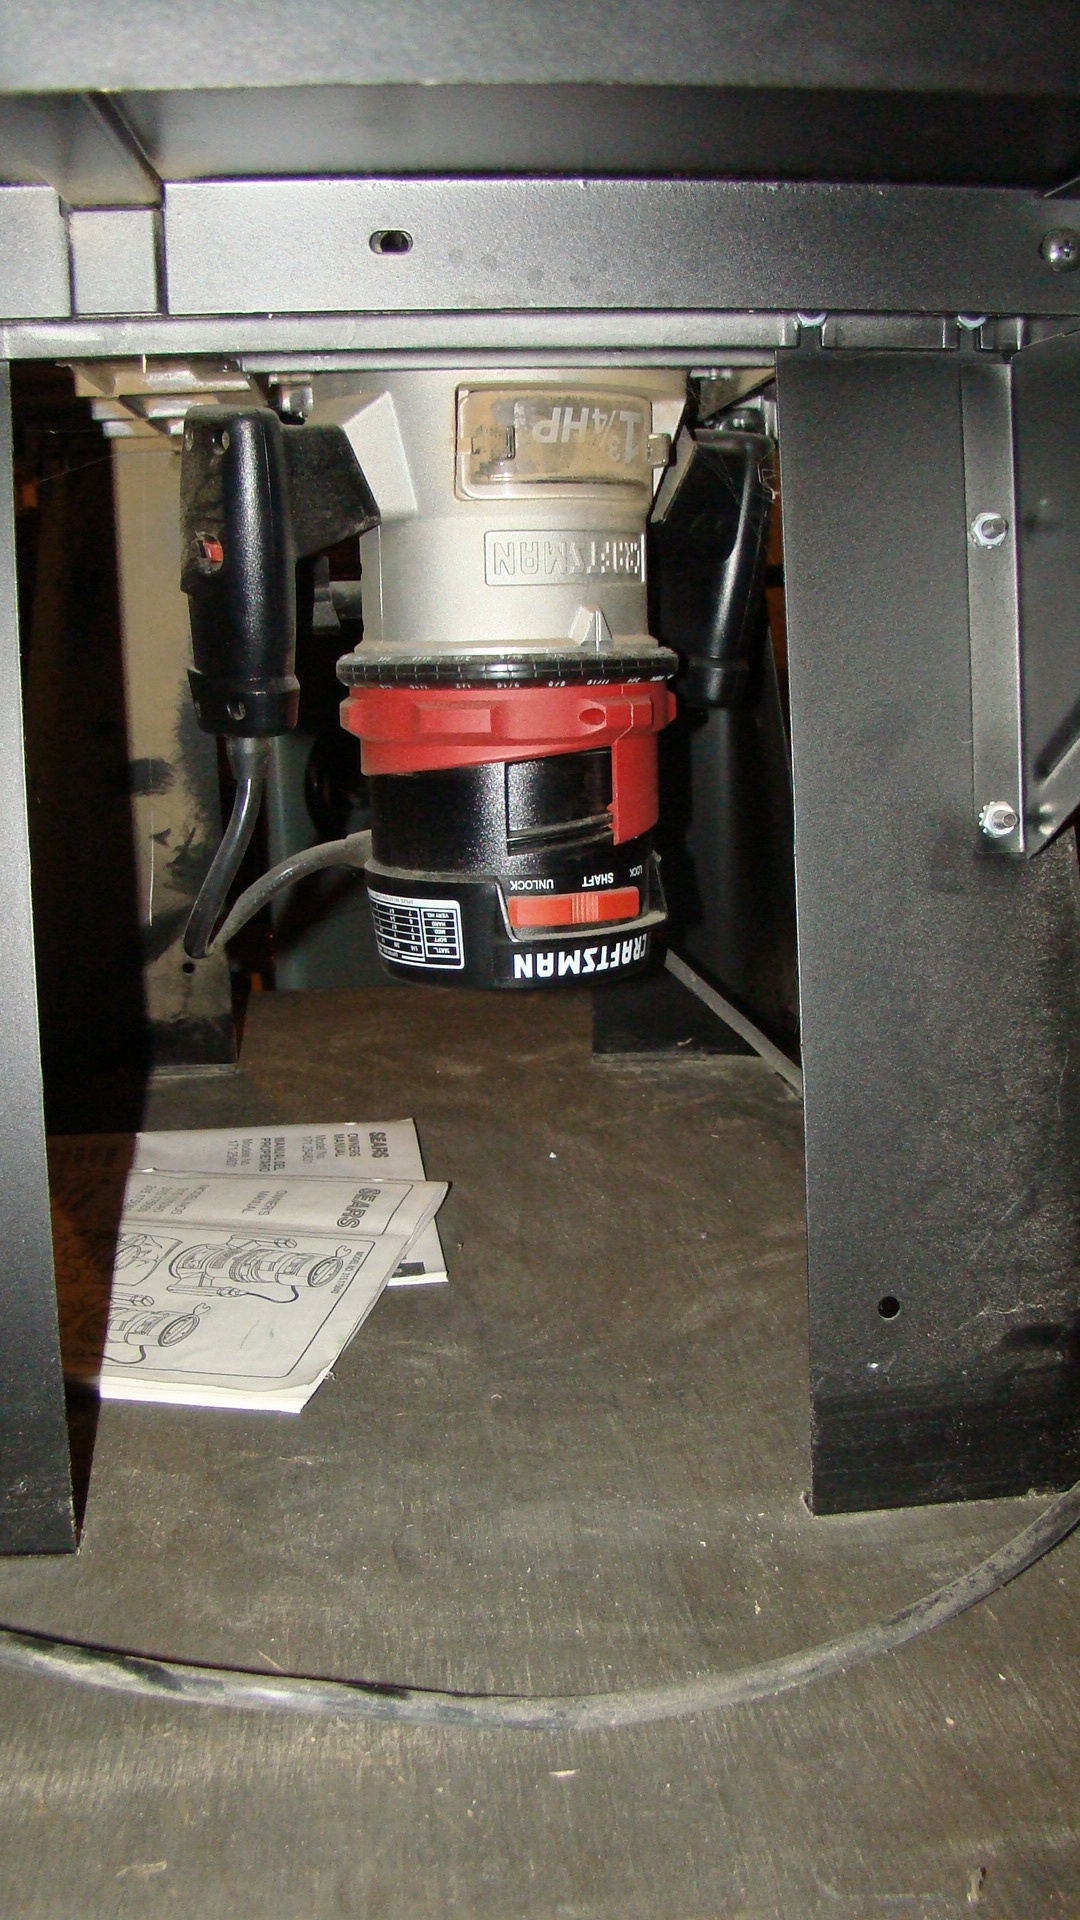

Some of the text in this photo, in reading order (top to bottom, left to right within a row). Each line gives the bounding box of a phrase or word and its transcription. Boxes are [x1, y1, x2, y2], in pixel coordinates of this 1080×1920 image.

[494, 541, 640, 575] CRAFTSMAN
[582, 872, 614, 888] SHAFT
[629, 864, 643, 877] LOCK
[510, 879, 554, 891] UNLOCK
[514, 933, 648, 979] CRAFTSMAN
[259, 1137, 271, 1173] PROPIETARIO
[274, 1137, 286, 1171] MANUAL DEL
[315, 1134, 327, 1151] Model
[333, 1133, 345, 1158] MANUAL
[369, 1131, 390, 1159] SEARS
[242, 1190, 270, 1213] MANUAL
[337, 1188, 381, 1228] SEARS
